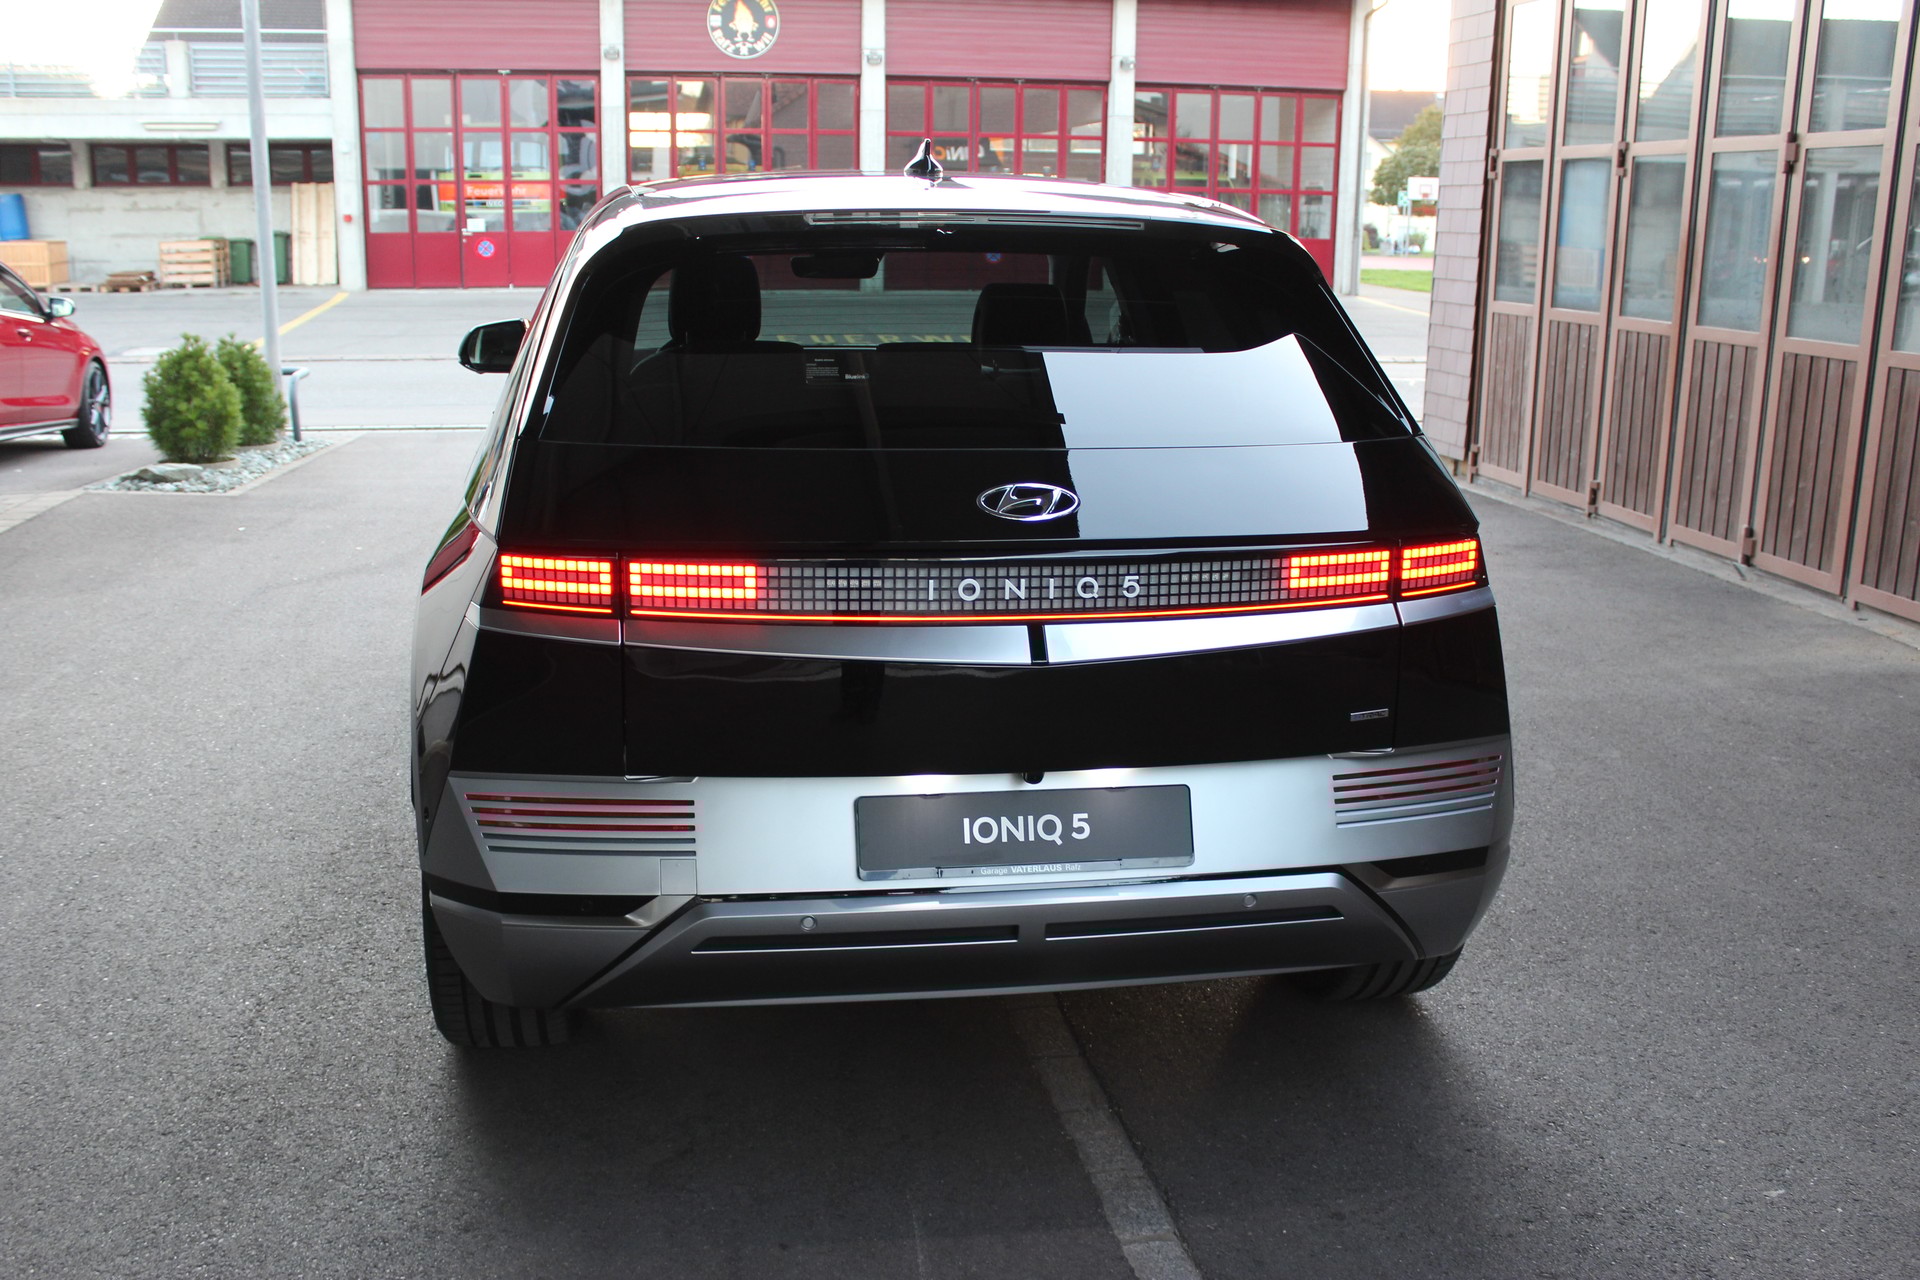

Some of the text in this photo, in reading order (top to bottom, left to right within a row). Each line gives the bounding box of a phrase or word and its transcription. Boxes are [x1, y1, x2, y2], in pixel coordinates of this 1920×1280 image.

[928, 575, 1141, 601] IONIQ 5
[963, 813, 1091, 846] IONIQ 5
[980, 863, 1081, 875] Garage VATERLAUS Rafz
